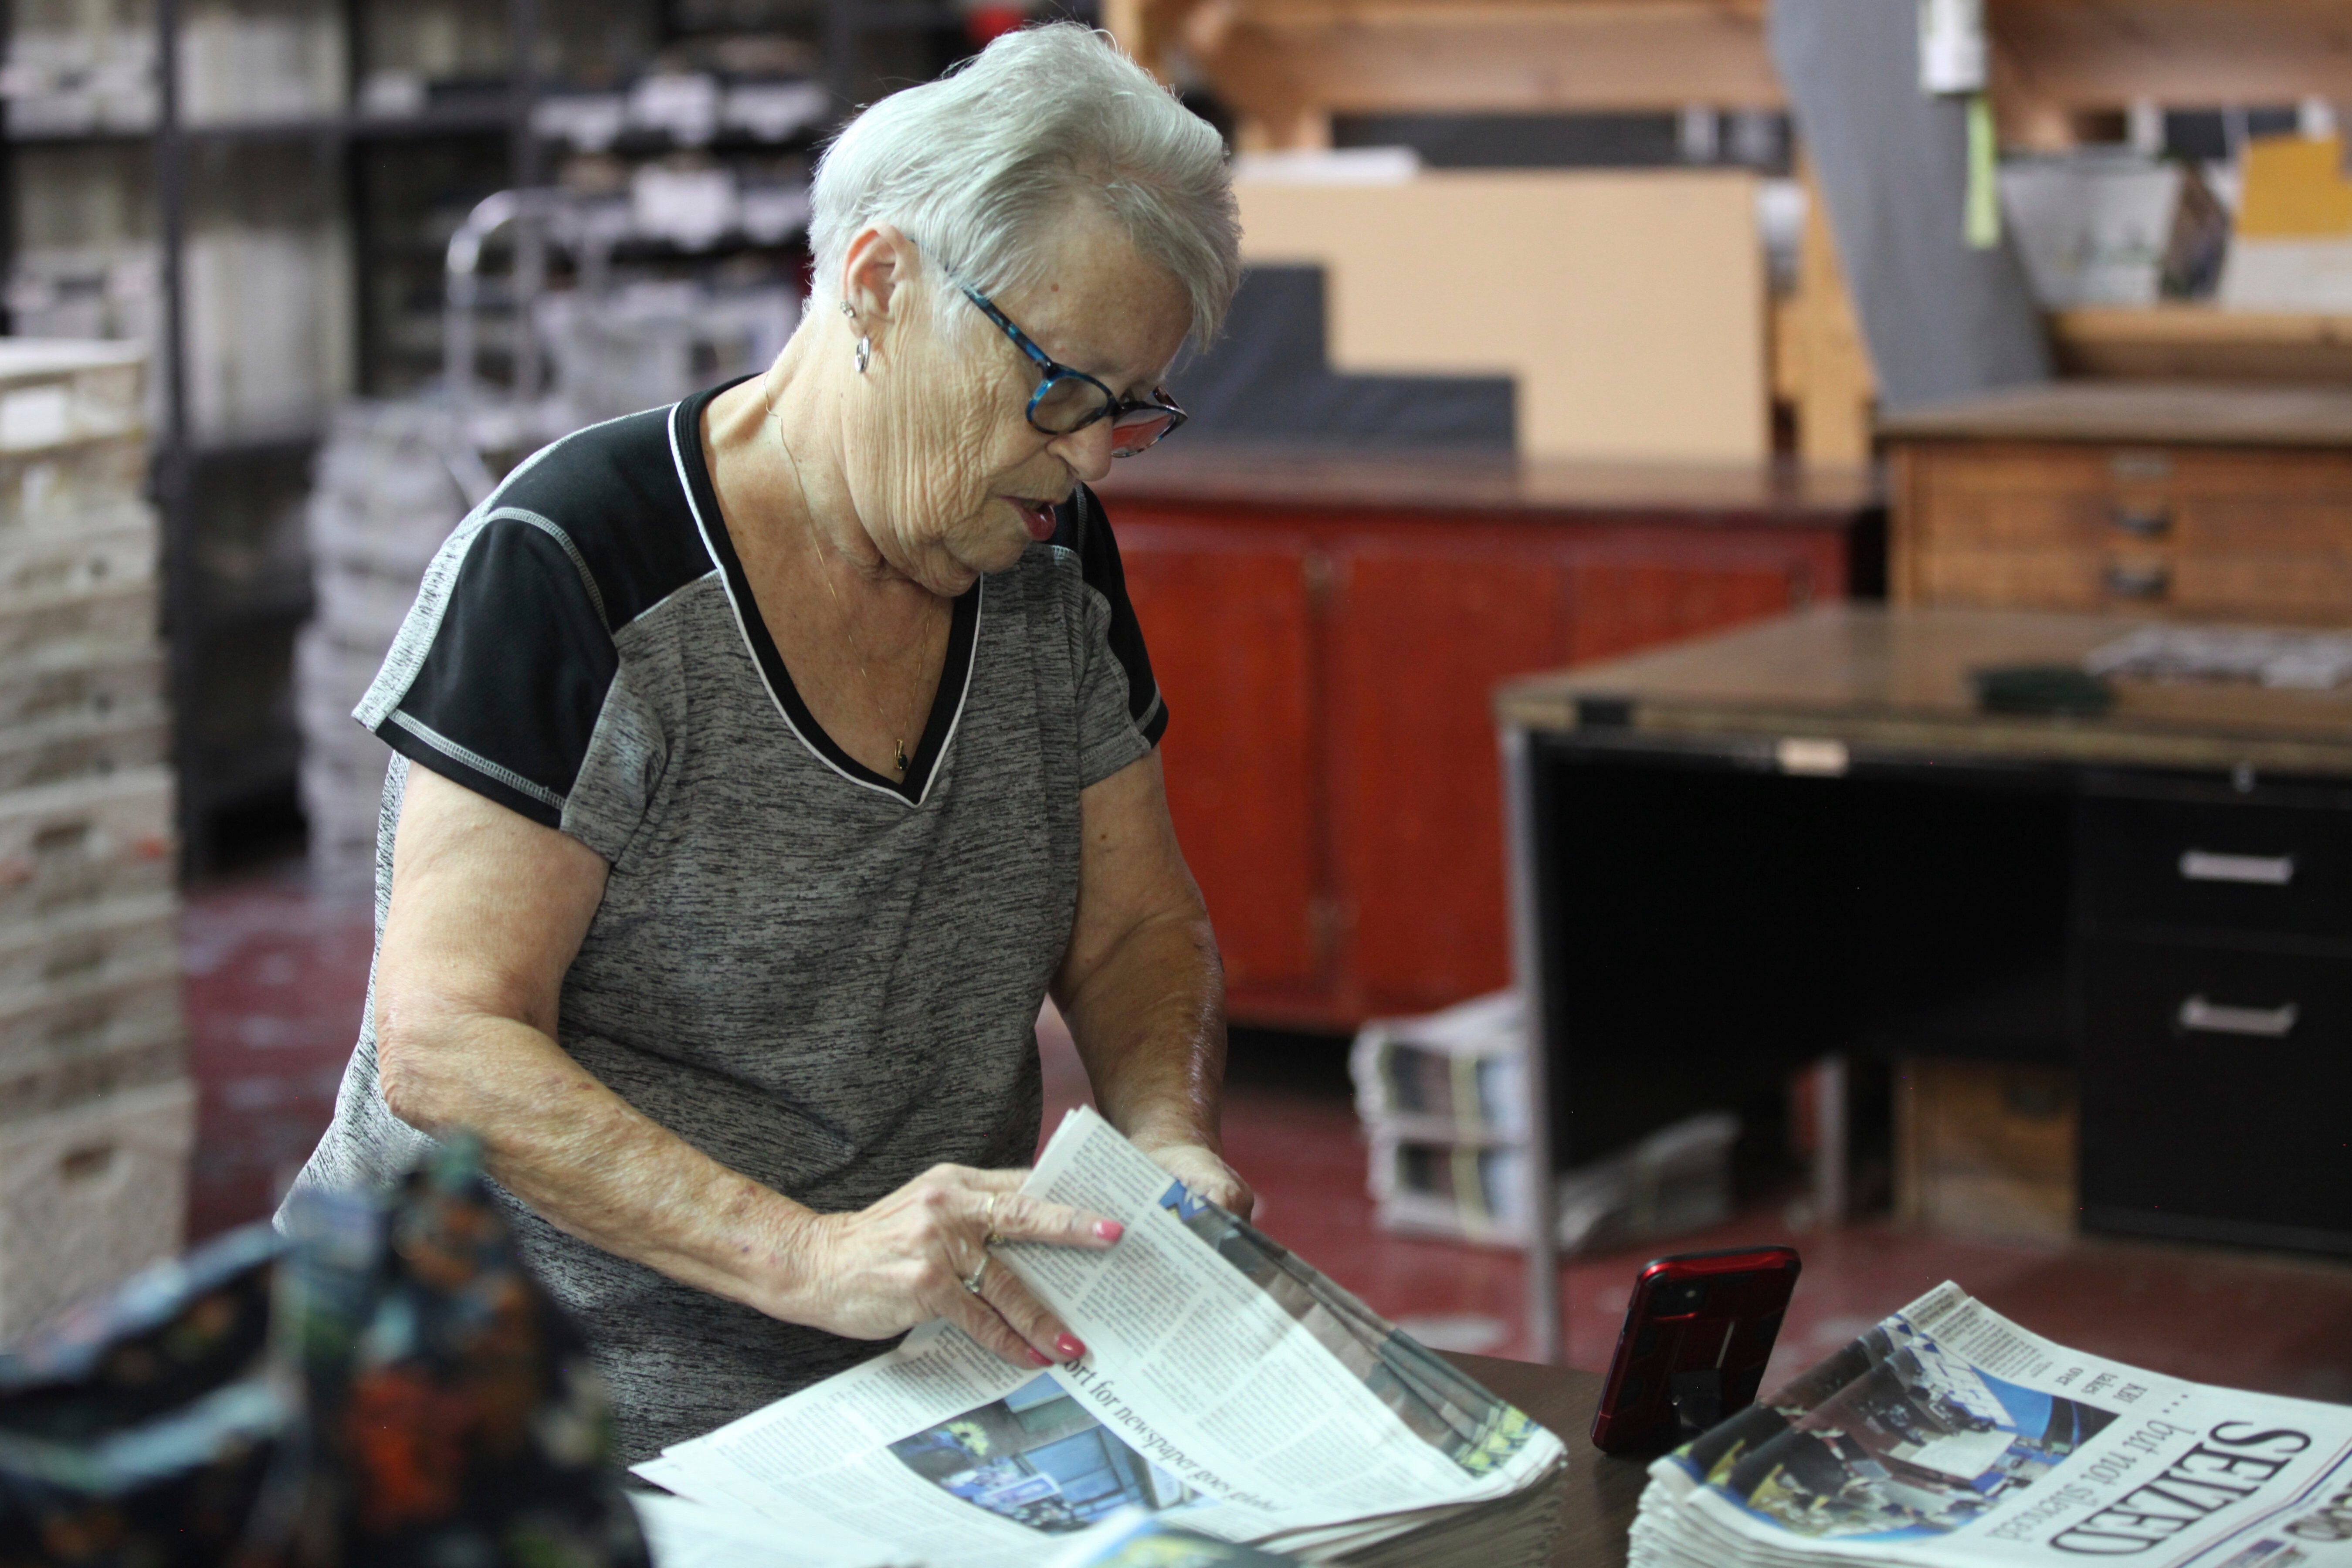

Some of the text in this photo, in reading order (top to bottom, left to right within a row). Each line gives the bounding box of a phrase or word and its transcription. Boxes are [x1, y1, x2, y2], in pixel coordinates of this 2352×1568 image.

[2054, 1367, 2084, 1387] over
[2080, 1371, 2120, 1395] takes
[2113, 1383, 2148, 1404] KBI
[1064, 1358, 1097, 1387] ort
[1089, 1380, 1121, 1407] for
[1113, 1403, 1200, 1471] newspaper
[1185, 1469, 1231, 1494] goes
[2080, 1451, 2139, 1486] not
[2048, 1419, 2312, 1557] SEIZED
[1985, 1483, 2099, 1544] silenced
